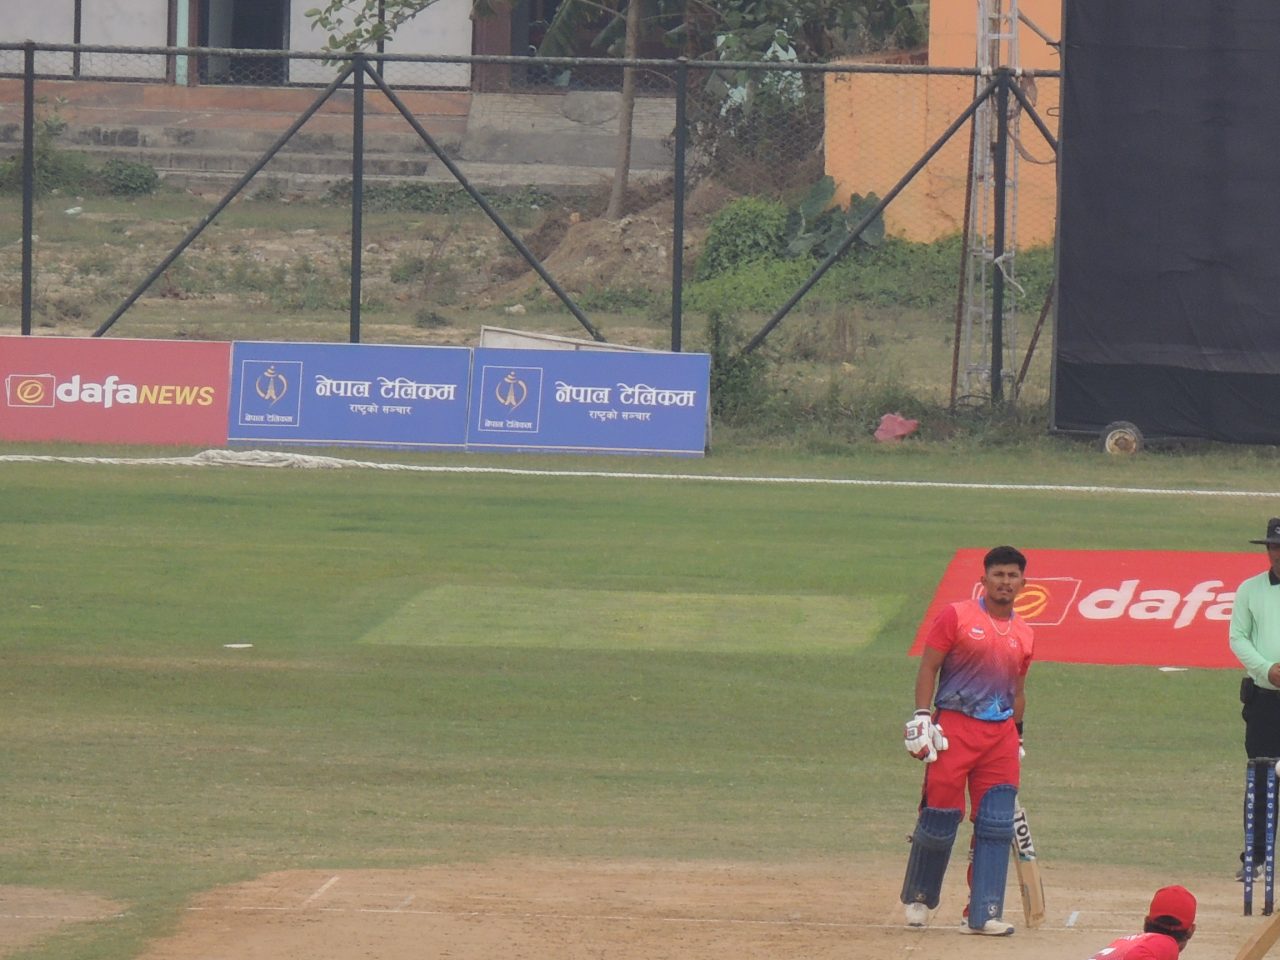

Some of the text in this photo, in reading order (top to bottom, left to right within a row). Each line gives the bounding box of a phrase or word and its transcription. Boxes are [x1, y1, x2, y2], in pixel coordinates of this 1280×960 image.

[315, 374, 457, 400] नेपाल टेलिकम
[555, 381, 697, 407] नेपाल टेलिकम
